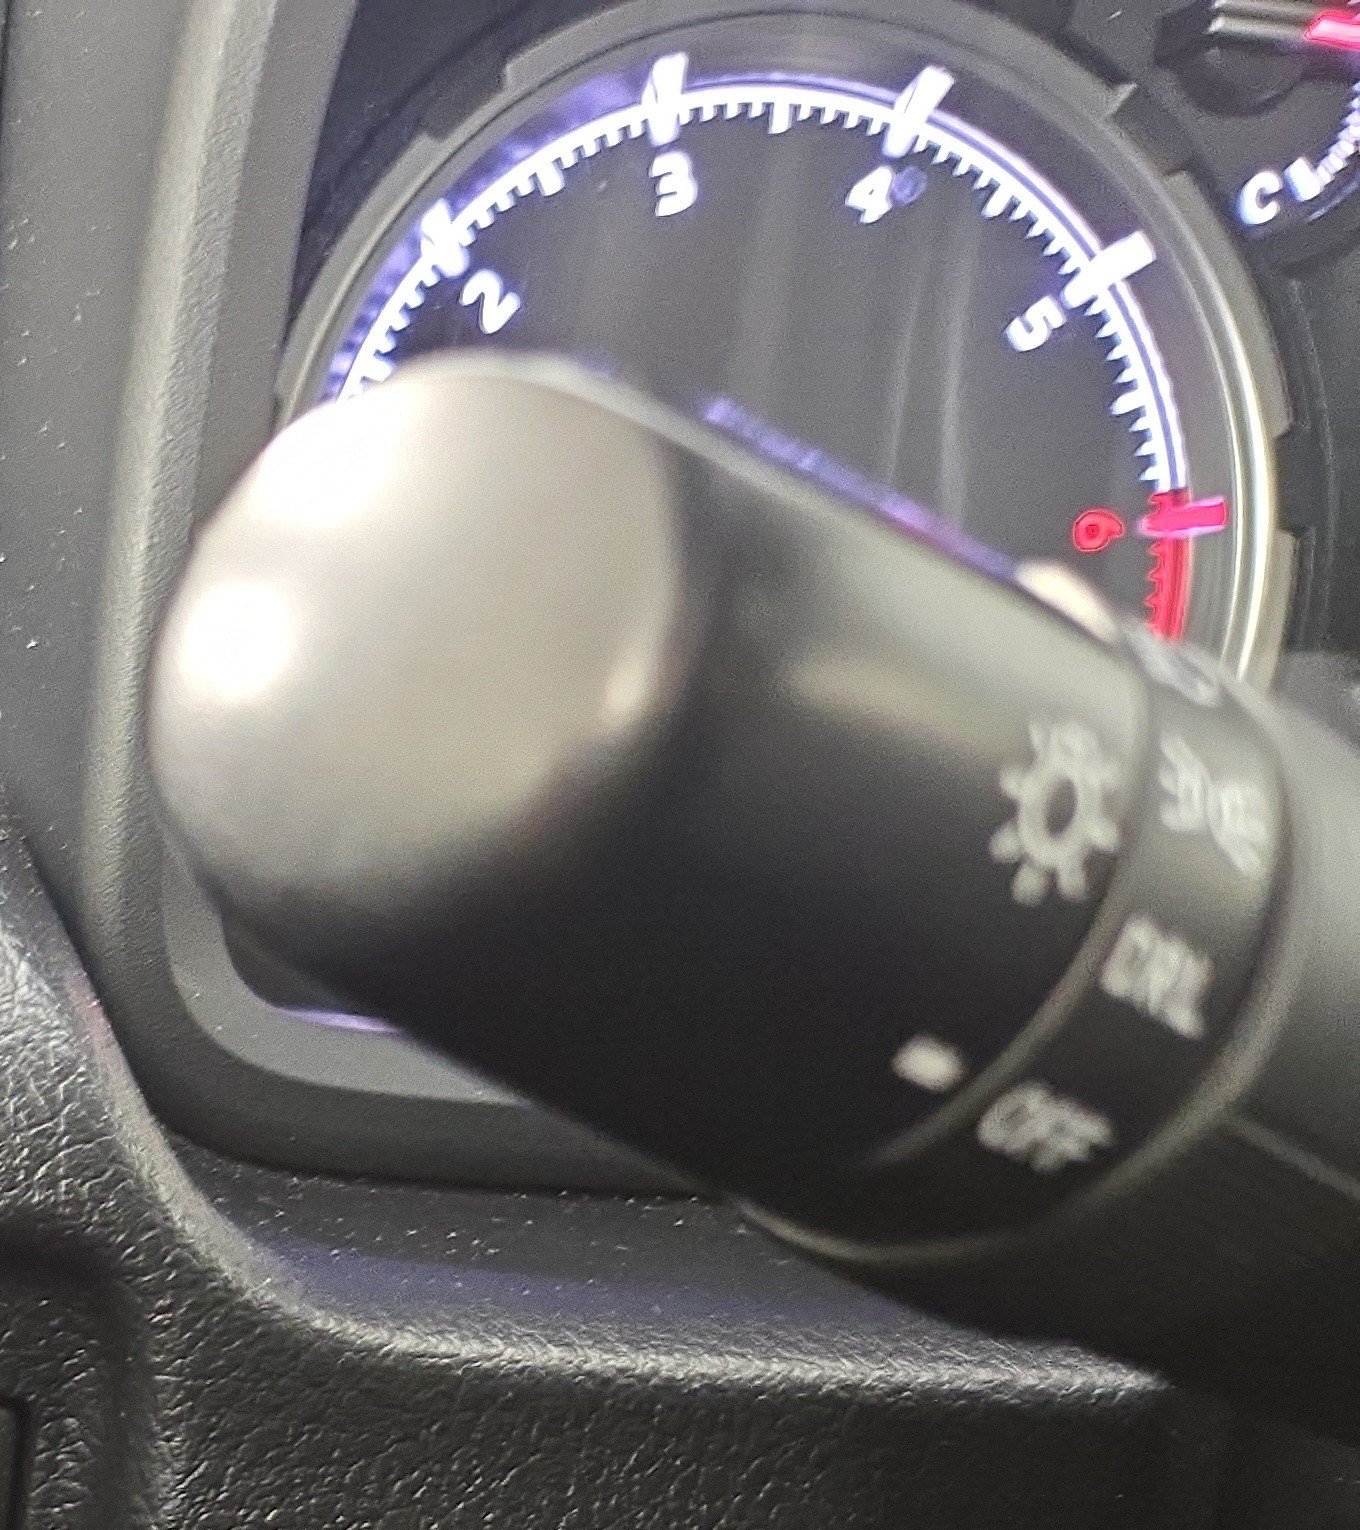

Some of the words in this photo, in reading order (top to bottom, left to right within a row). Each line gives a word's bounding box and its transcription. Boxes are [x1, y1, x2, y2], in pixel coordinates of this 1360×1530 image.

[648, 148, 699, 218] 3
[846, 165, 894, 224] 4
[1239, 169, 1282, 226] C
[460, 270, 522, 335] 2
[1006, 296, 1064, 353] 5
[1072, 508, 1124, 553] 6
